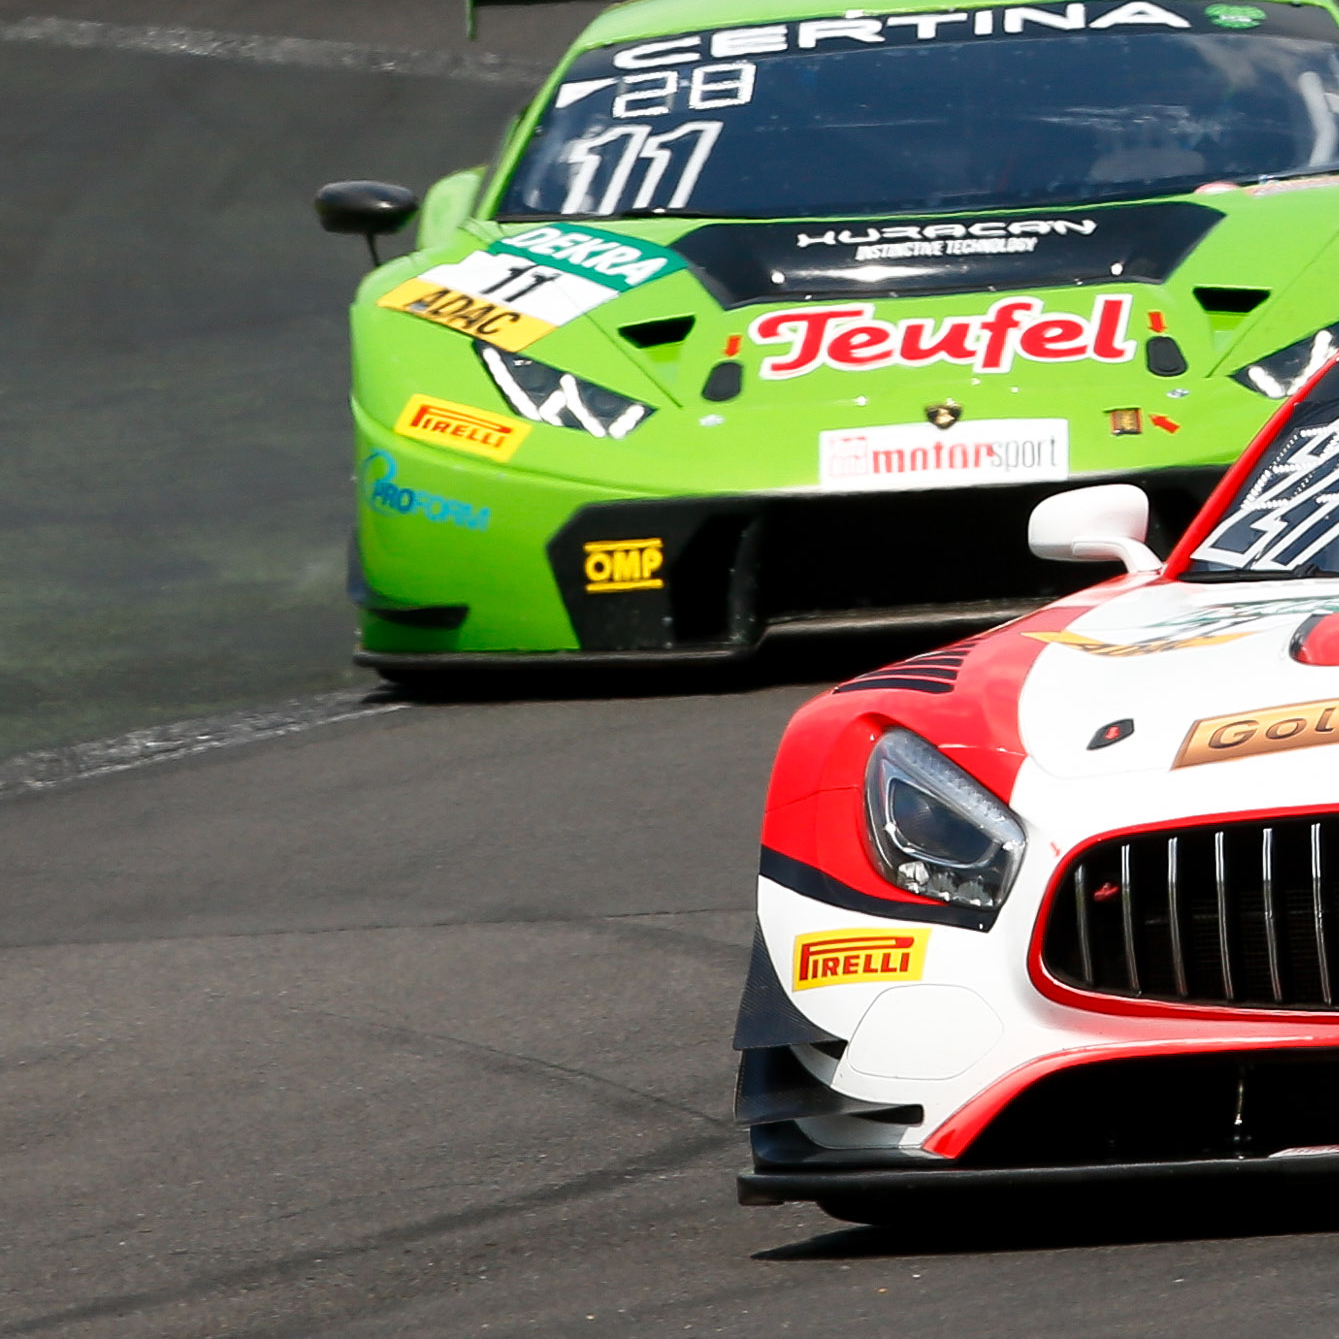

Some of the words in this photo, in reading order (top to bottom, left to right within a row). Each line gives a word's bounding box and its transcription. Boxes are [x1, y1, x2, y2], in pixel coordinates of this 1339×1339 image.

[614, 1, 1190, 72] CERTINA
[796, 219, 1098, 247] HURACAN
[503, 226, 670, 287] DEKRA
[480, 262, 557, 304] 11
[402, 290, 521, 337] ADAC
[755, 298, 1129, 372] Teufel
[410, 404, 513, 449] PIRELLI
[584, 547, 664, 582] OMP
[799, 936, 915, 981] PIRELLI
